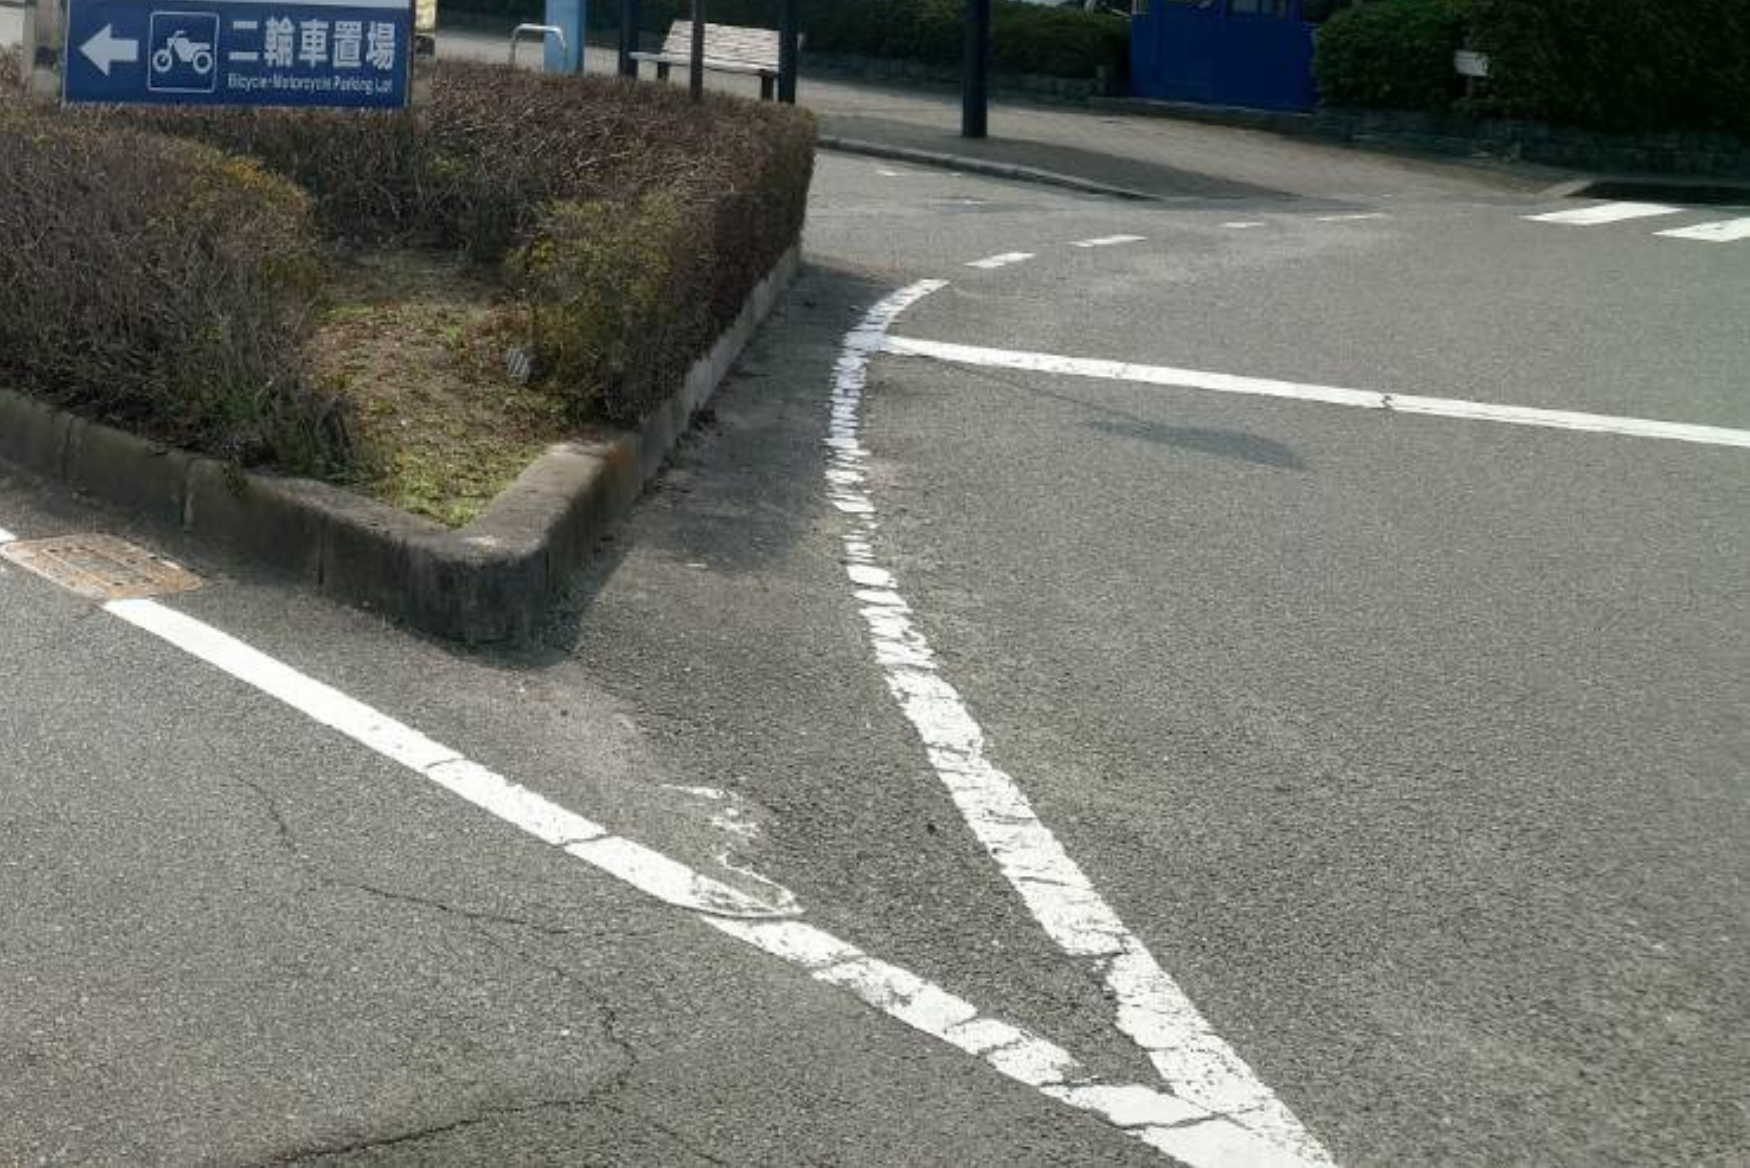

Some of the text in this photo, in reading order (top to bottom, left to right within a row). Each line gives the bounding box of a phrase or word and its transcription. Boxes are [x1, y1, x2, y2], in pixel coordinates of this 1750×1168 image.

[227, 16, 396, 71] 二輪車置場
[334, 74, 373, 95] Parking
[375, 77, 394, 93] Lot
